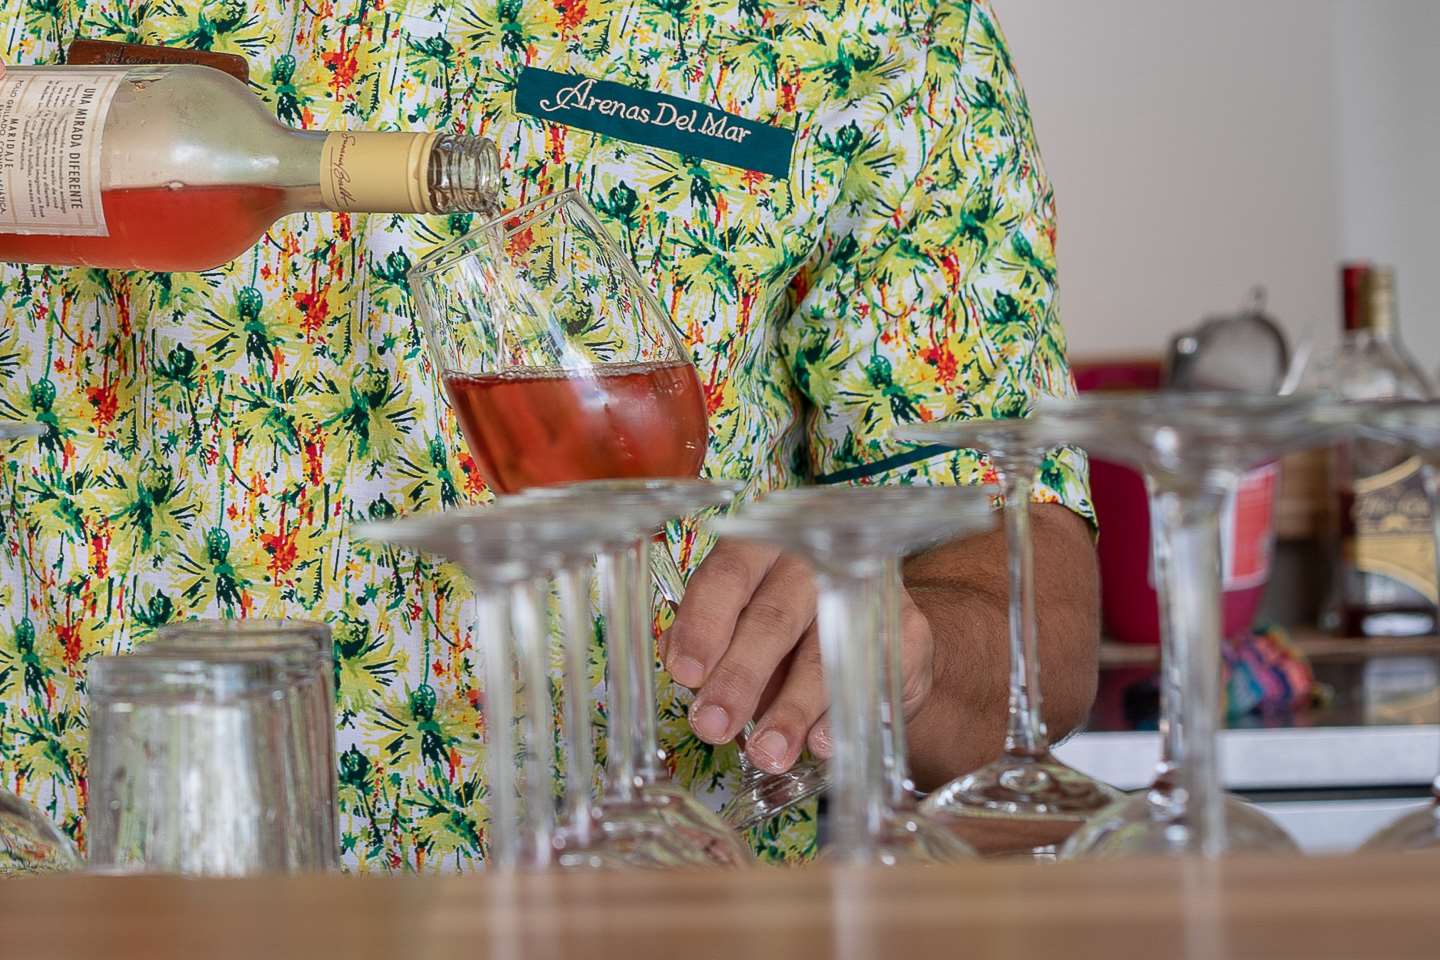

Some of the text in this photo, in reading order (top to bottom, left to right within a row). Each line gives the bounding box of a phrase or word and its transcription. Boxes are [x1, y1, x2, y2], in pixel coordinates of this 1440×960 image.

[79, 88, 97, 105] UNA
[539, 77, 753, 143] Arenas Del Mar
[4, 118, 20, 169] MARIDAJE
[69, 108, 88, 148] MIRADA
[69, 152, 84, 209] DIFERENTE
